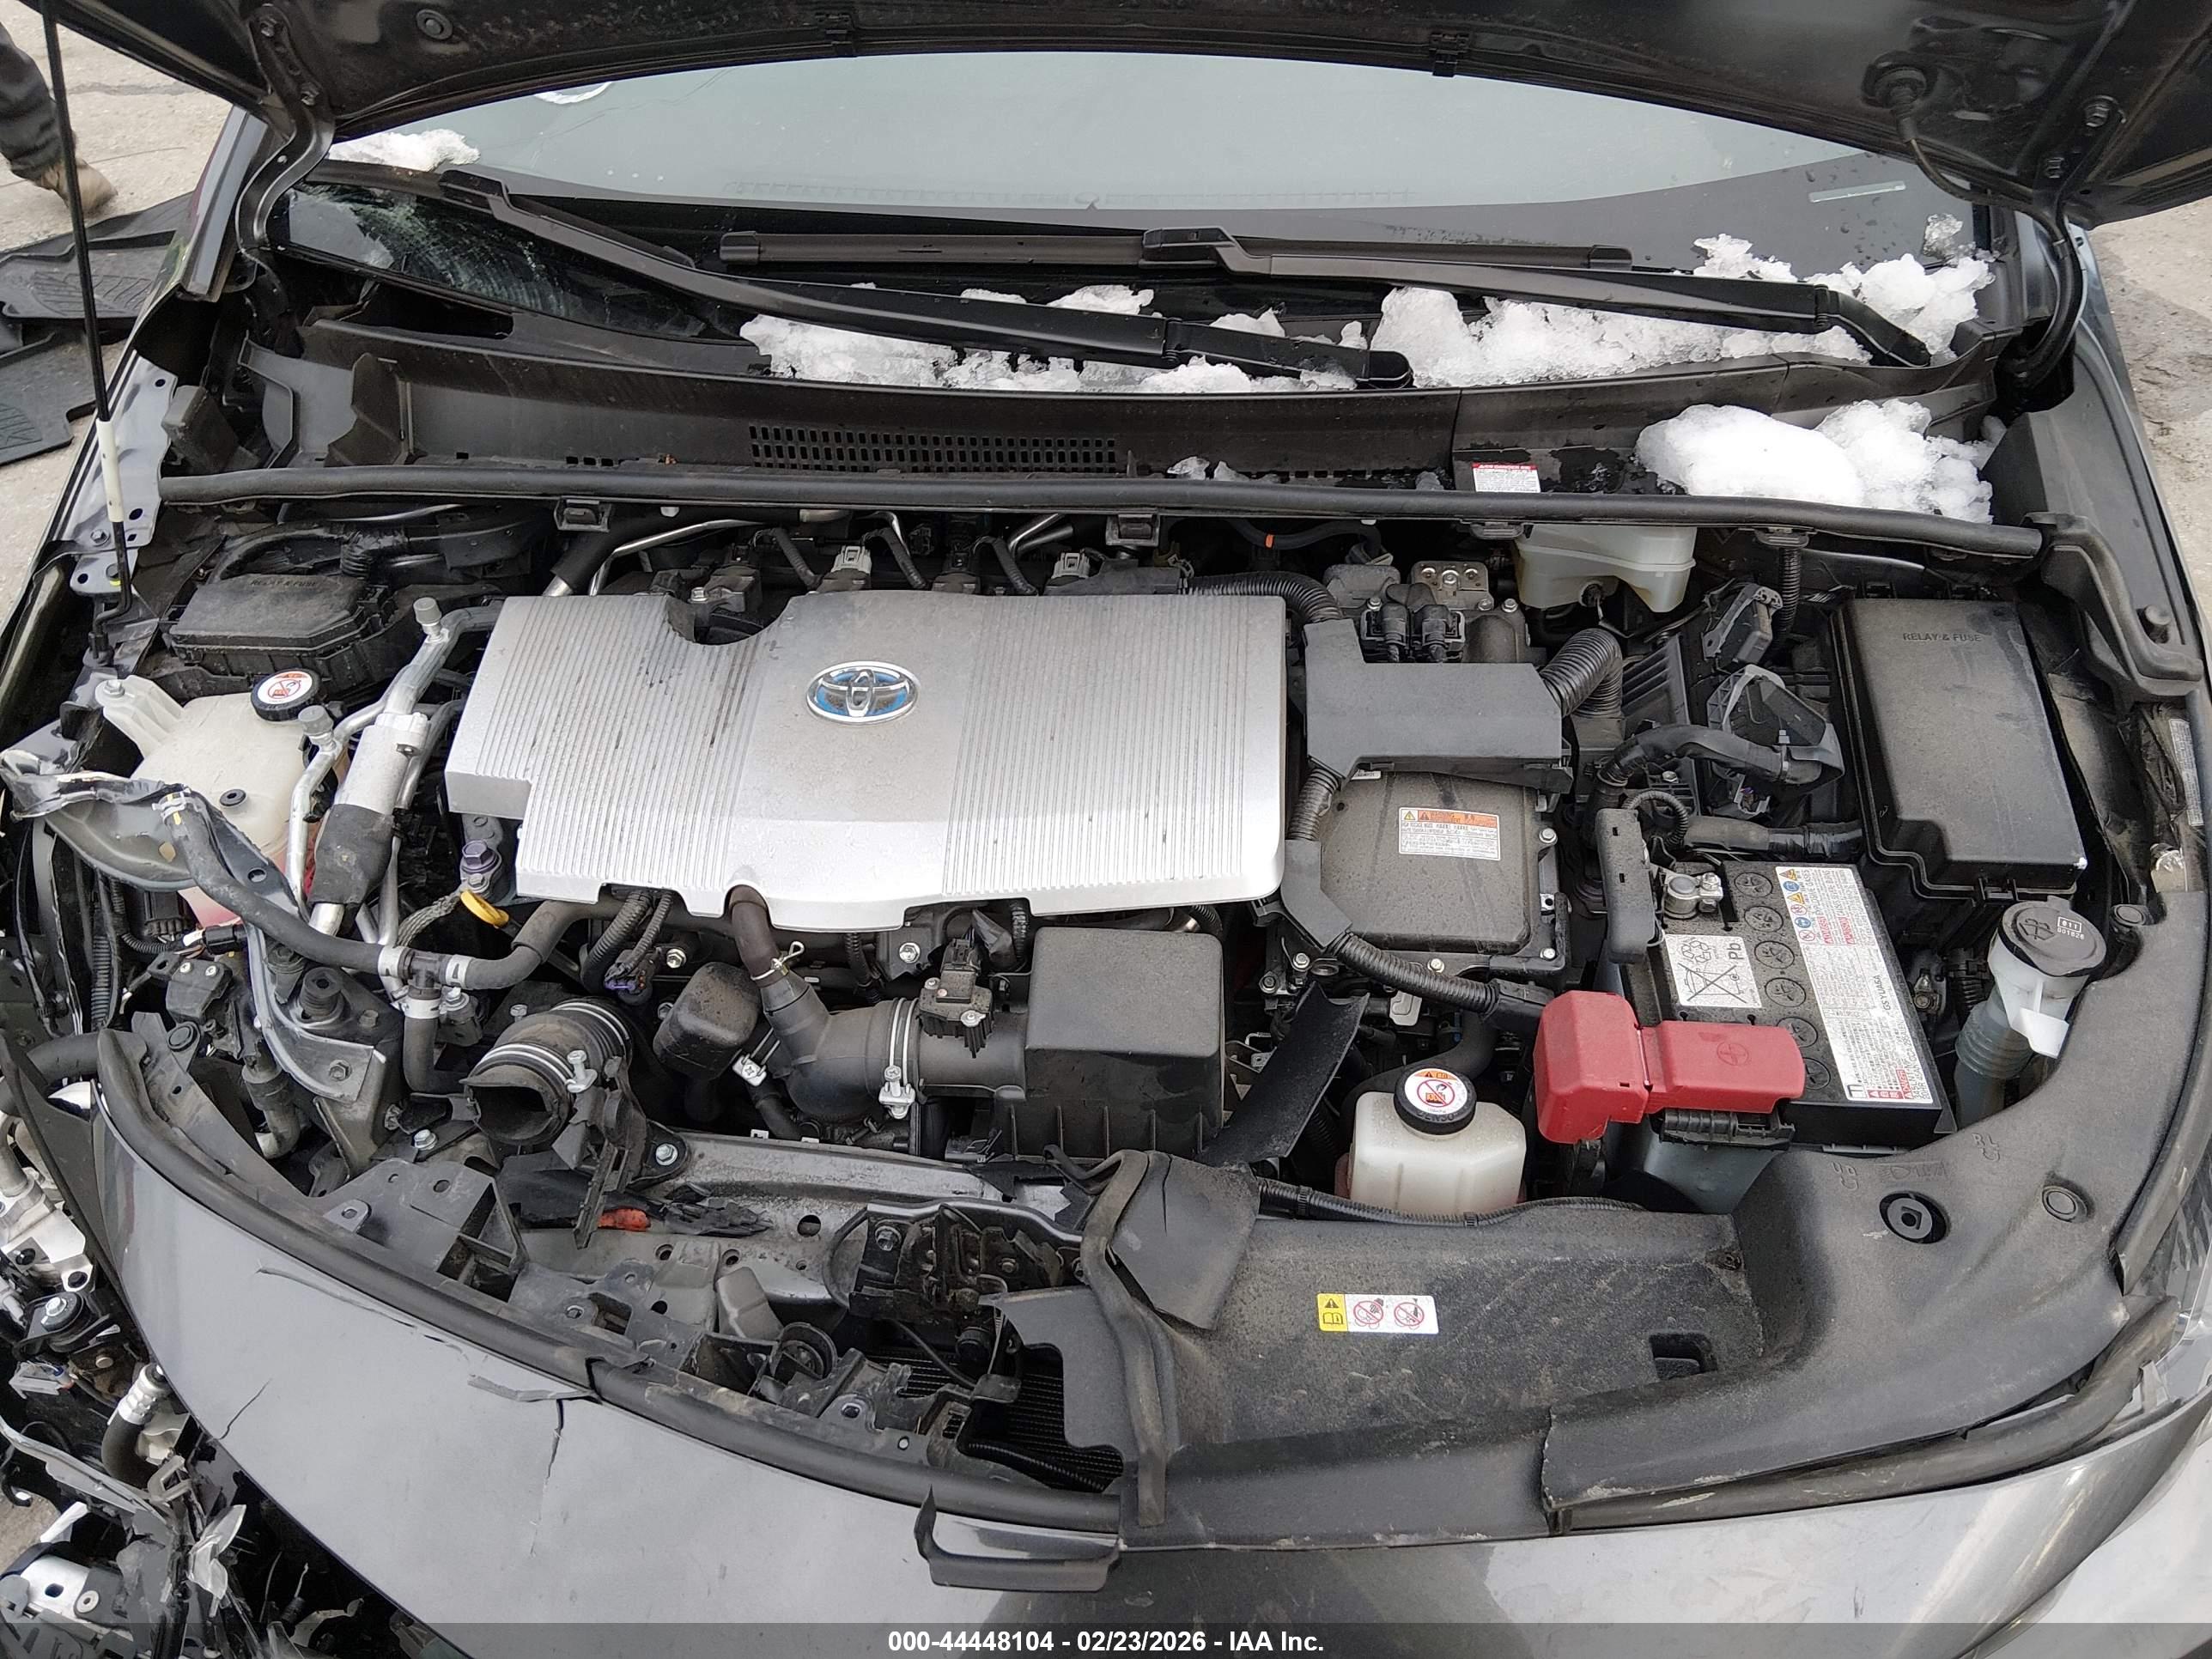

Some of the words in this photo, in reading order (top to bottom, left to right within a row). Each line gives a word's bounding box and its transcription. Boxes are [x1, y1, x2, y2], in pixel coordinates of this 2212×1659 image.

[1903, 632, 1939, 641] RELAY
[1952, 634, 1983, 642] FUSE
[1723, 942, 1745, 960] Pb
[1871, 974, 1888, 999] YUASA
[1881, 1000, 1892, 1010] GS
